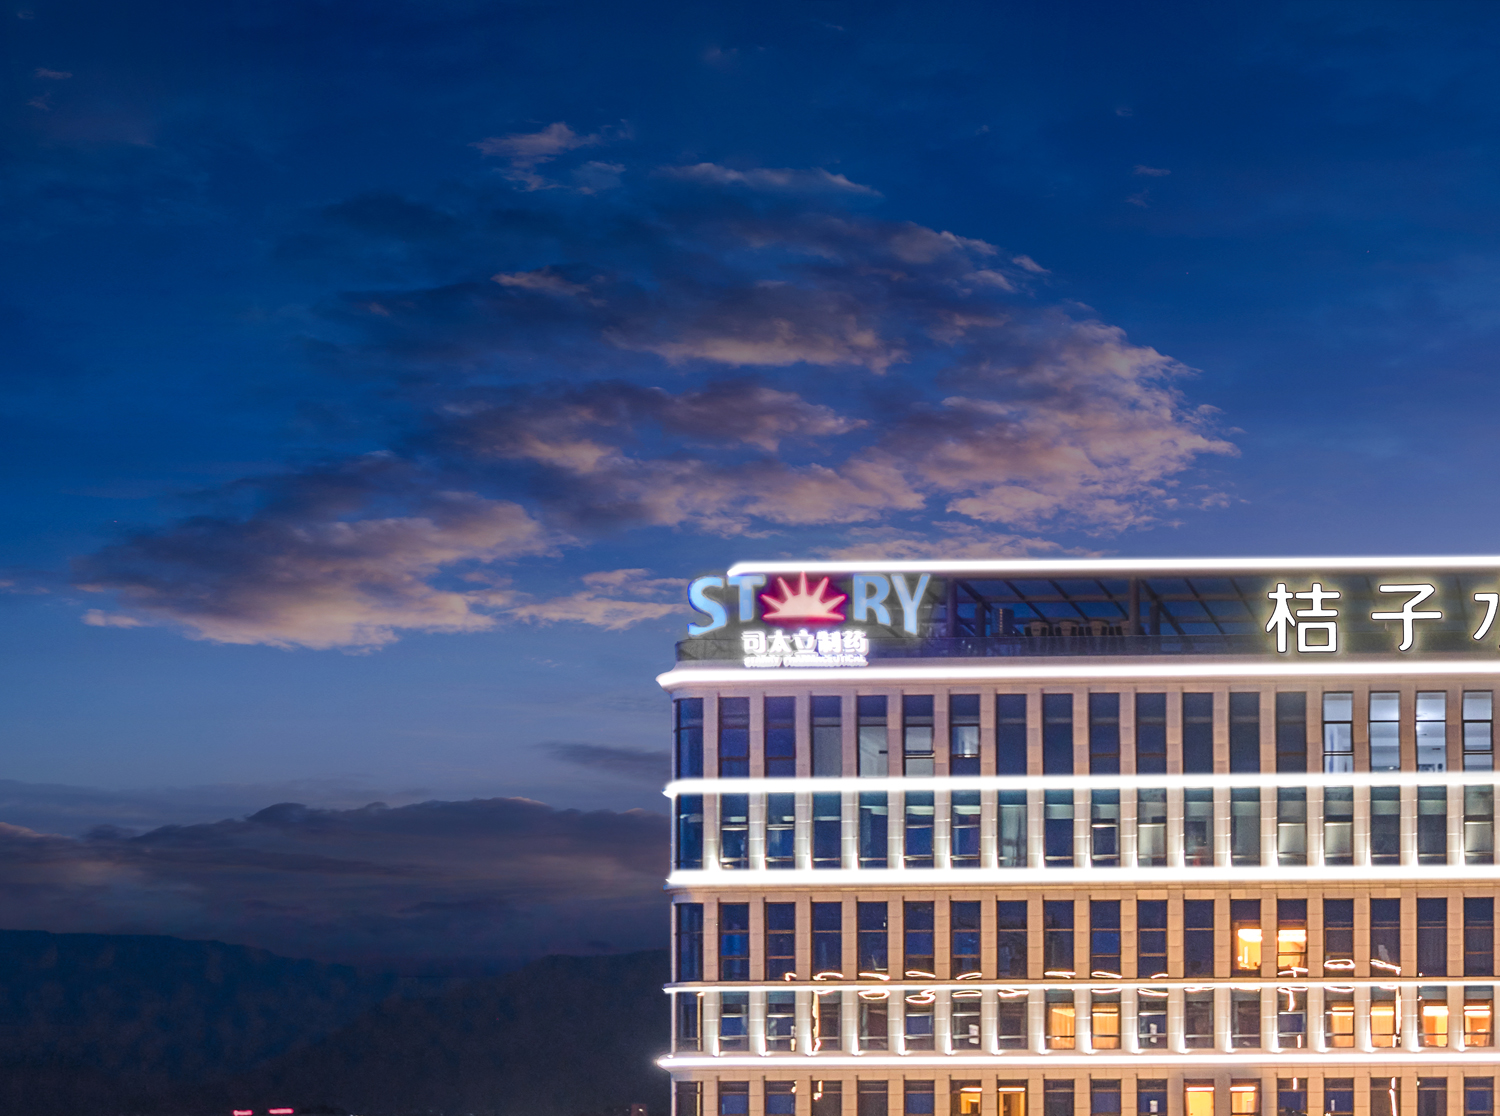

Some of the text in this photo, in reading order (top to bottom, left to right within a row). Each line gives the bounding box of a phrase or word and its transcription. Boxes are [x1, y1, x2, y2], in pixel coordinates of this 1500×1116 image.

[742, 629, 868, 655] 司太立制药
